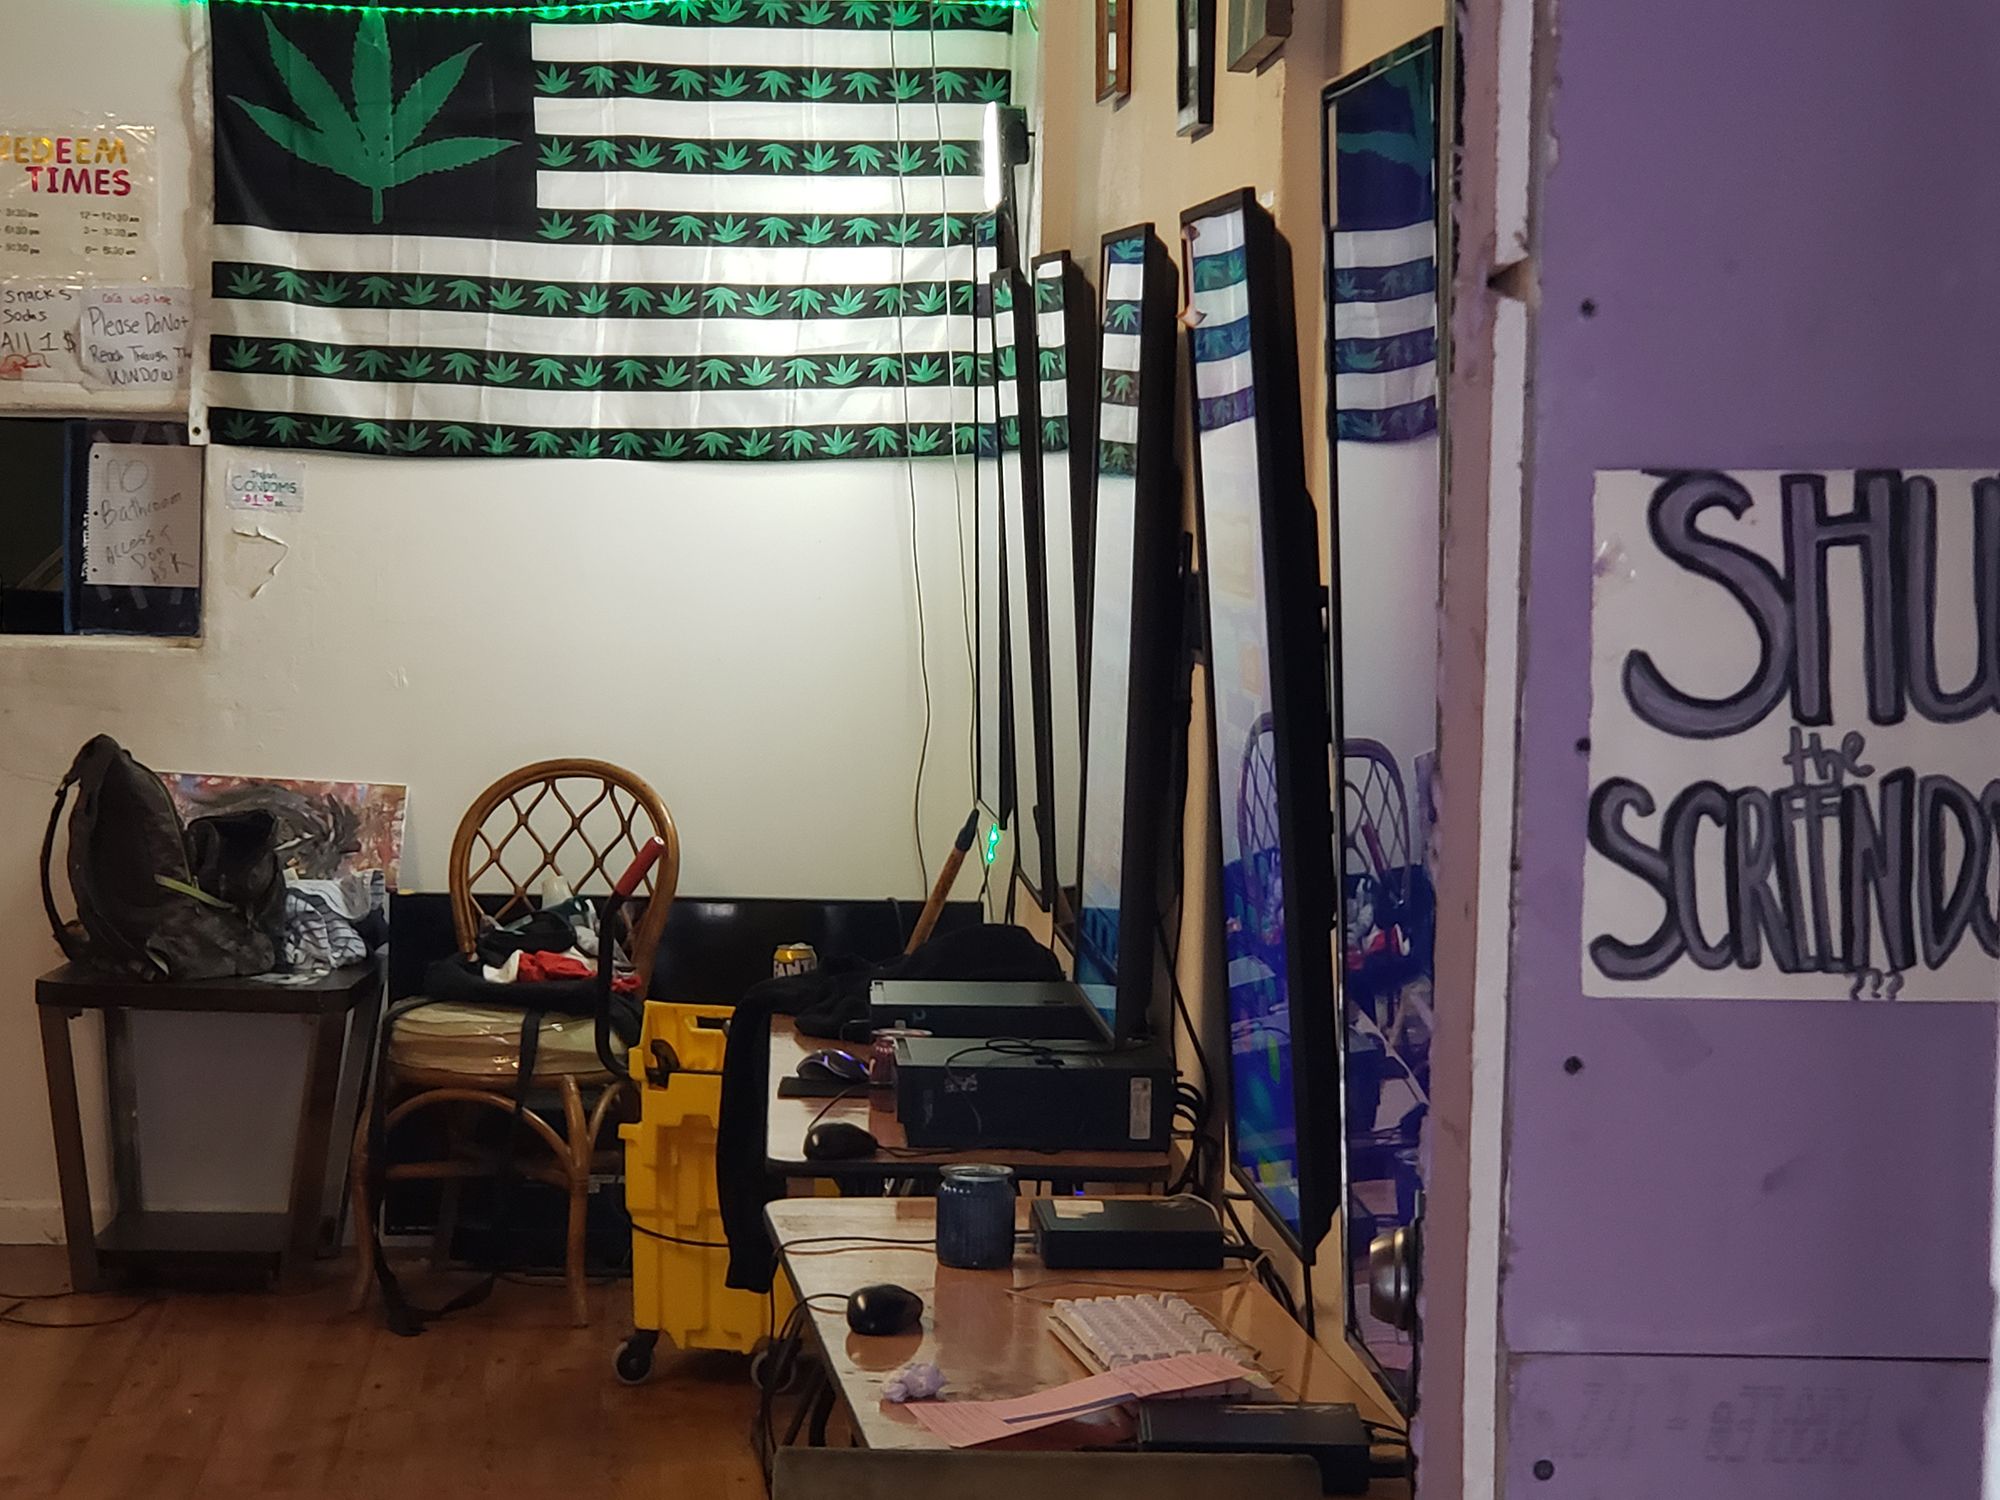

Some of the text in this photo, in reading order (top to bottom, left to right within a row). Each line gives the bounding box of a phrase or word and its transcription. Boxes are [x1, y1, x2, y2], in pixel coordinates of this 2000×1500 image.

[25, 165, 131, 196] TIMES
[88, 306, 140, 337] Please
[1, 331, 32, 354] All
[231, 475, 297, 495] CONDOMS
[1782, 725, 1876, 786] the
